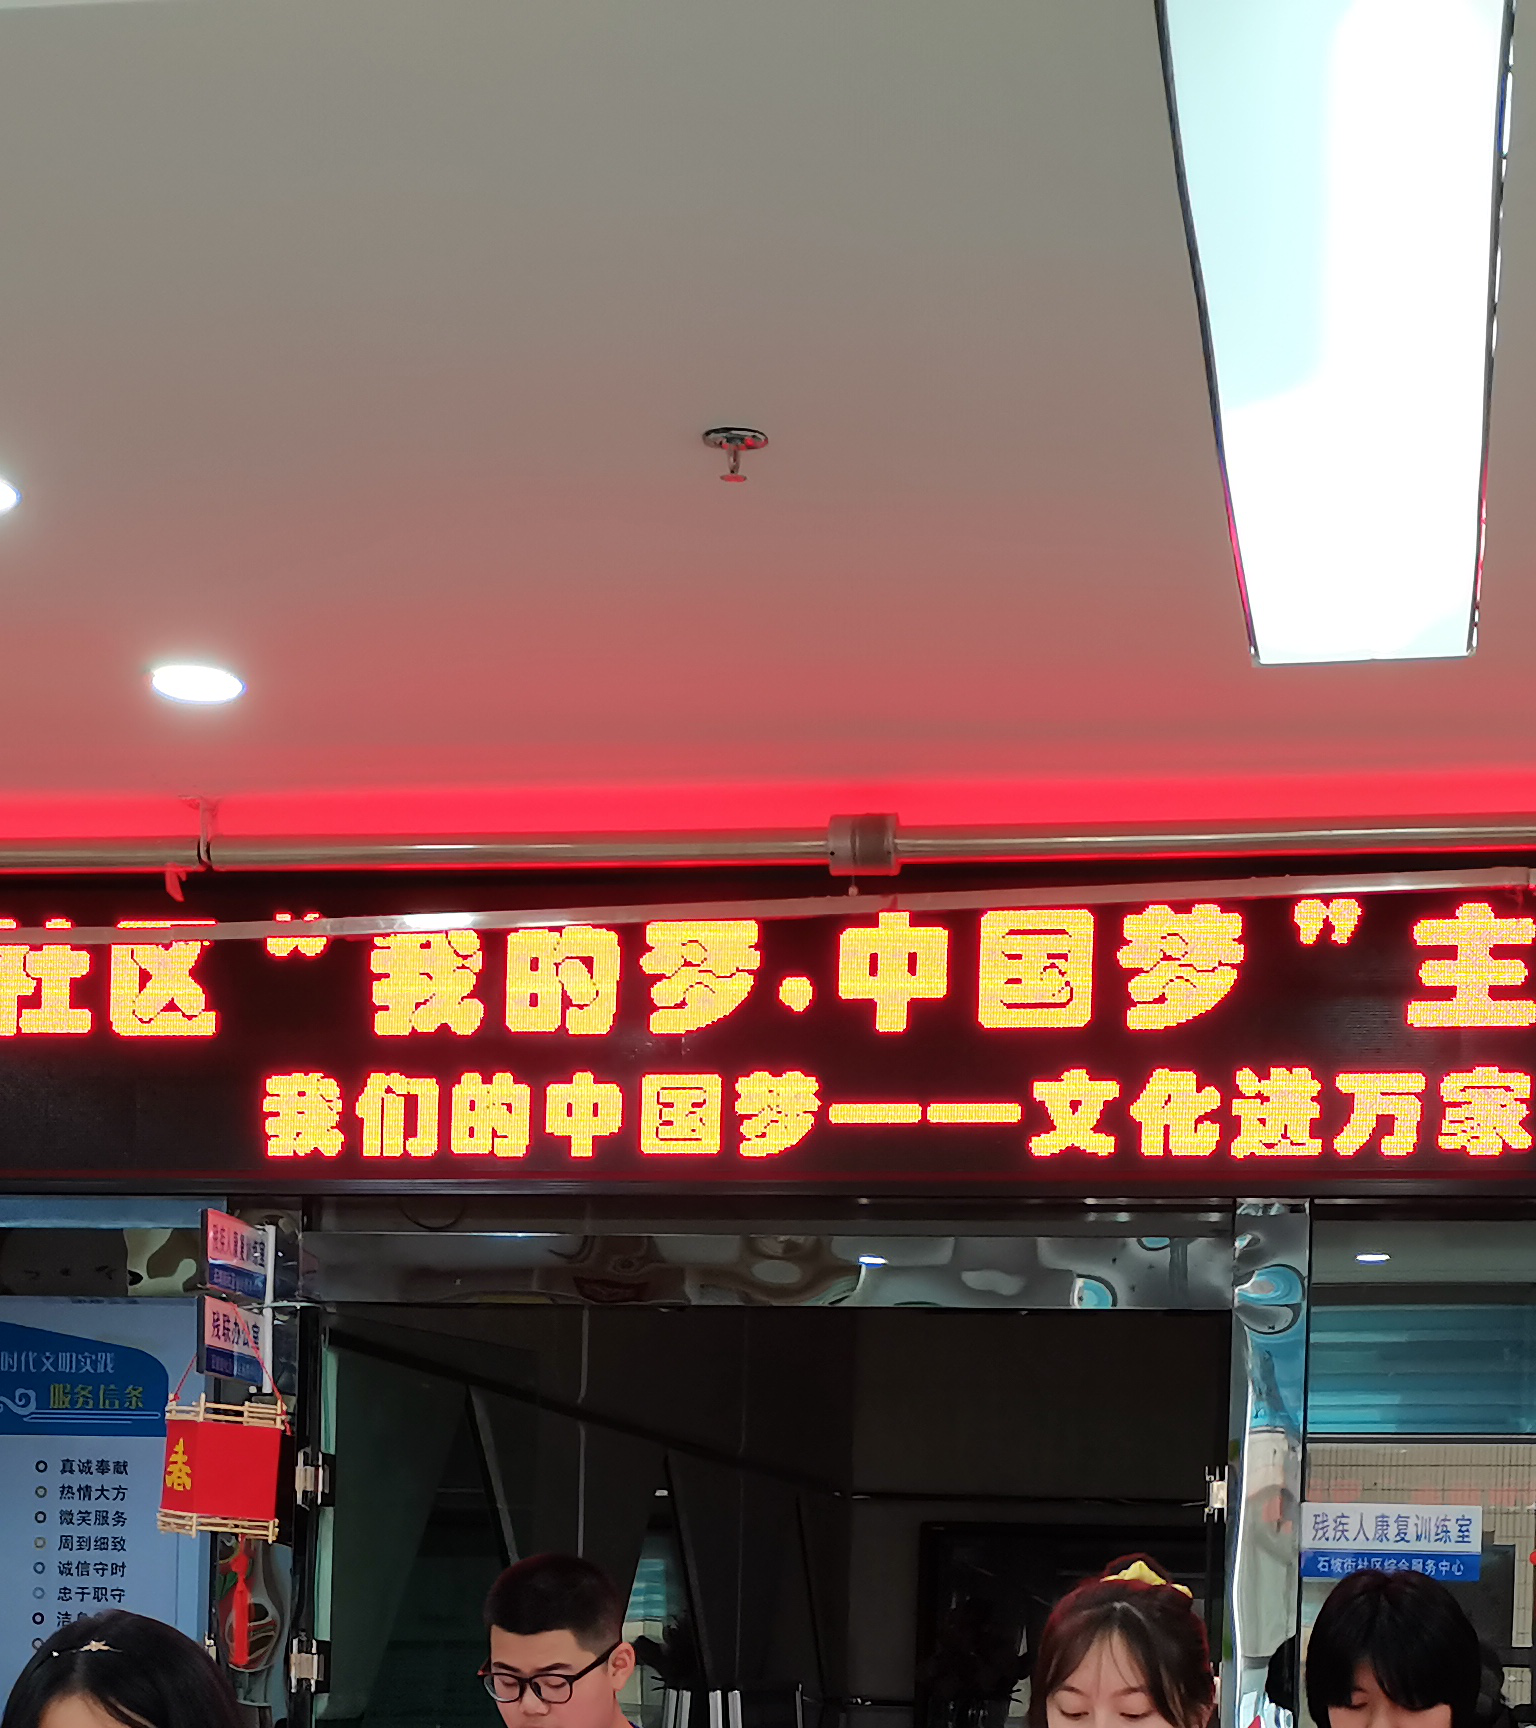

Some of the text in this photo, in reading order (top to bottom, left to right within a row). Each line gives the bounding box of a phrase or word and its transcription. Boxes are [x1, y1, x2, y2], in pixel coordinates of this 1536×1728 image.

[49, 1383, 145, 1410] 服务信条
[59, 1458, 129, 1476] 真诚奉献
[165, 1438, 192, 1491] 春
[58, 1484, 129, 1502] 热情大方
[58, 1509, 128, 1527] 微笑服务
[1311, 1512, 1473, 1545] 残疾人康复训练室
[57, 1535, 127, 1552] 周到细致
[57, 1560, 127, 1578] 诚信守时
[56, 1586, 126, 1604] 忠于职守
